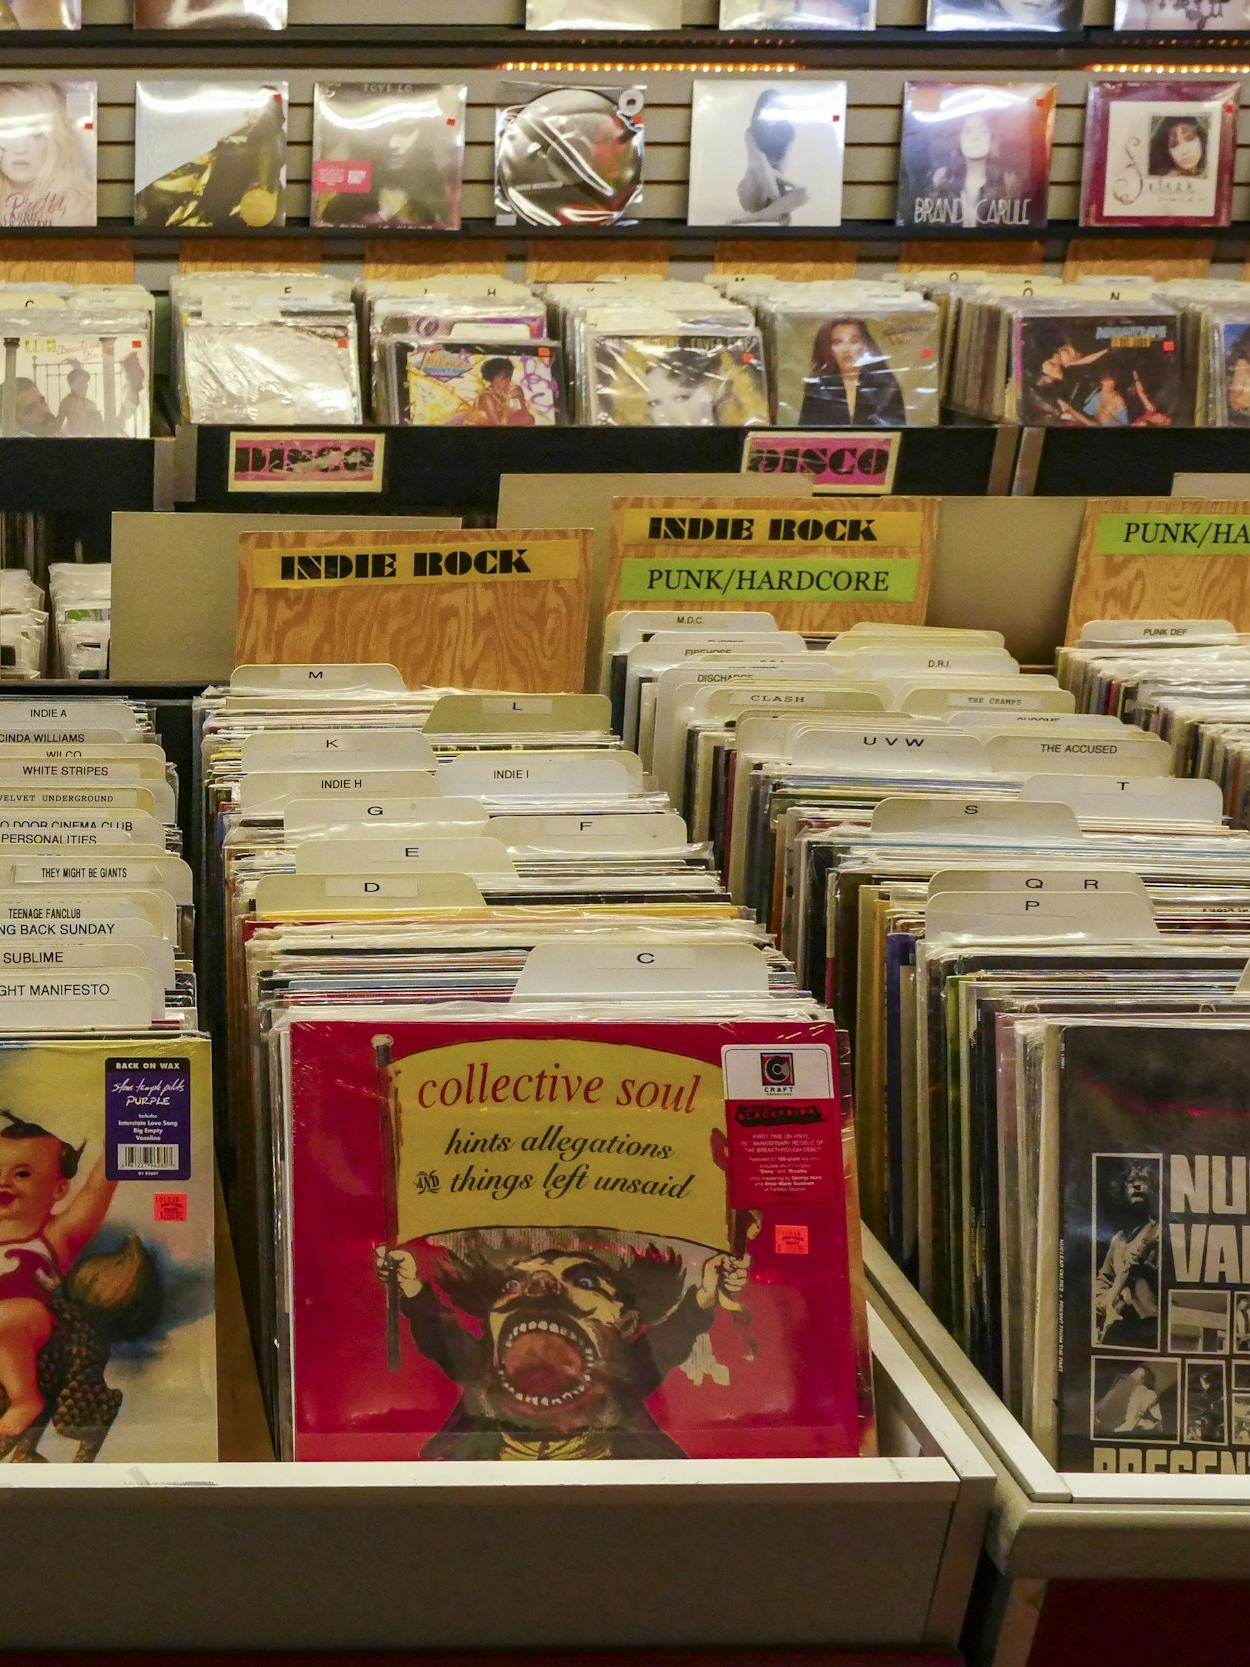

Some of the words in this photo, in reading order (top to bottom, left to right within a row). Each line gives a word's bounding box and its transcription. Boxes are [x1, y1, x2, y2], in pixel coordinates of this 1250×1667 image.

[747, 447, 890, 475] DISCO
[649, 517, 754, 542] INDIE
[768, 518, 878, 542] ROCK
[281, 553, 396, 580] INDIE
[413, 549, 532, 577] ROCK
[647, 567, 890, 595] PUNK/HARDCORE
[1143, 628, 1167, 636] PUNK
[1170, 628, 1188, 636] DEF
[308, 671, 324, 679] M
[751, 695, 805, 703] CLASH
[512, 702, 523, 711] L
[30, 709, 58, 718] INDIE
[60, 709, 67, 718] A
[33, 733, 85, 743] WILLIAMS
[863, 737, 877, 746] U
[886, 737, 898, 746] V
[905, 738, 925, 747] W
[326, 739, 339, 748] K
[1040, 744, 1063, 753] THE
[1066, 744, 1118, 754] ACCUSED
[23, 766, 58, 776] WHITE
[61, 766, 109, 776] STRIPES
[493, 770, 522, 779] INDIE
[321, 780, 350, 789] INDIE
[353, 780, 363, 789] H
[1116, 782, 1130, 790] T
[42, 794, 114, 803] UNDERGROUND
[367, 806, 384, 816] G
[965, 805, 979, 815] S
[580, 822, 593, 831] F
[1, 834, 97, 844] PERSONALITIES
[405, 848, 419, 857] E
[41, 868, 61, 878] THEY
[62, 868, 85, 878] MIGHT
[88, 868, 97, 878] BE
[100, 868, 127, 878] GIANTS
[363, 882, 380, 893] D
[1025, 877, 1044, 889] Q
[1083, 878, 1099, 890] R
[1025, 900, 1041, 911] P
[8, 909, 43, 919] TEENAGE
[46, 908, 81, 919] FANCLUB
[20, 924, 56, 935] BACK
[59, 923, 115, 934] SUNDAY
[3, 952, 64, 963] SUBLIME
[637, 953, 655, 964] C
[30, 983, 110, 996] MANIFESTO
[418, 1062, 604, 1109] collective
[616, 1074, 702, 1114] soul
[125, 1095, 170, 1107] PURPLE
[444, 1128, 512, 1156] hints
[520, 1125, 673, 1162] allegations
[450, 1165, 535, 1200] things
[542, 1163, 590, 1200] left
[594, 1174, 695, 1200] unsaid
